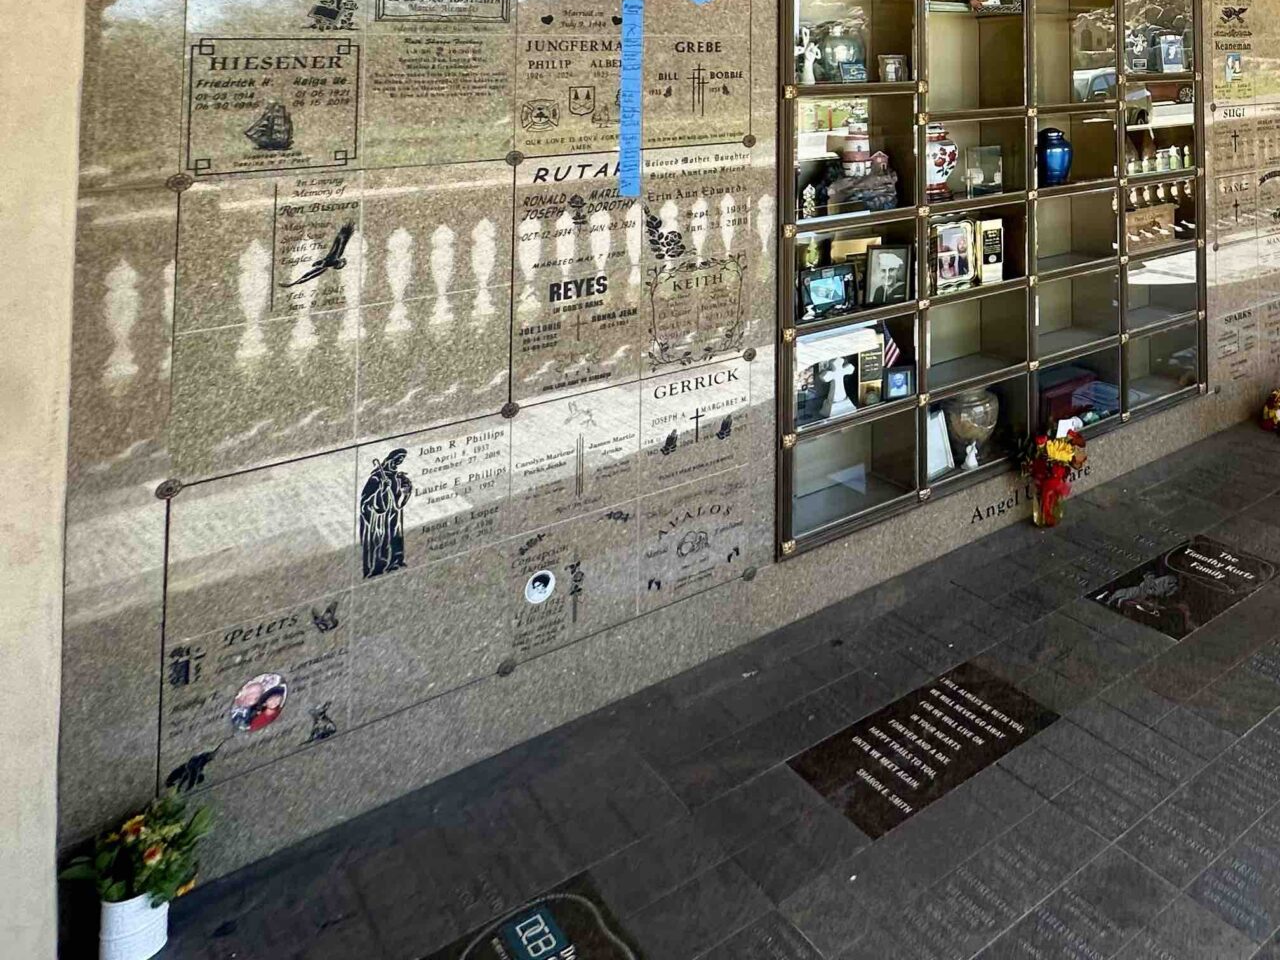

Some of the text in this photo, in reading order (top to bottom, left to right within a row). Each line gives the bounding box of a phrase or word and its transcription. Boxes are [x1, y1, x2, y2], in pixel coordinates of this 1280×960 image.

[675, 41, 722, 53] GREBE
[1215, 41, 1252, 51] Keaneman
[209, 55, 344, 71] HIESENER
[528, 59, 573, 70] PHILIP
[658, 70, 744, 81] BILL BOBBIE
[645, 158, 680, 168] Beloved
[681, 156, 710, 165] Mother
[293, 188, 333, 198] Memory
[522, 193, 567, 208] RONALD
[648, 192, 673, 202] Erin
[701, 184, 748, 197] Edwards
[280, 204, 305, 217] Ron
[522, 199, 637, 221] JOSEPH DOROTHY
[532, 258, 574, 270] MARRIED
[549, 275, 608, 303] REYES
[673, 274, 723, 292] KEITH
[1224, 309, 1252, 325] SPARKS
[653, 367, 740, 400] GERRICK
[651, 399, 738, 428] JOSEPH MARGARET
[418, 429, 505, 457] John Phillips
[421, 460, 463, 475] December
[434, 452, 458, 463] April
[515, 454, 546, 471] Carolyn
[415, 466, 508, 498] Laurie Phillips
[427, 491, 460, 506] January
[970, 489, 1020, 524] Angel
[422, 505, 500, 534] Jason Lopez
[658, 504, 734, 540] AVALOS
[1184, 547, 1257, 581] Timothy Kurtz
[1218, 550, 1240, 564] The
[1189, 561, 1227, 581] Family
[223, 614, 298, 647] Peters
[957, 688, 1011, 724] ALWAYS WITH
[920, 700, 975, 738] FOR LIVE
[953, 704, 1007, 739] NEVER AWAY
[868, 725, 913, 761] HAPPY TRAILS
[888, 719, 932, 752] FOREVER AND
[918, 719, 962, 751] YOUR HEARTS
[851, 735, 900, 773] UNTIL MEET
[856, 768, 913, 815] SHARON SMITH
